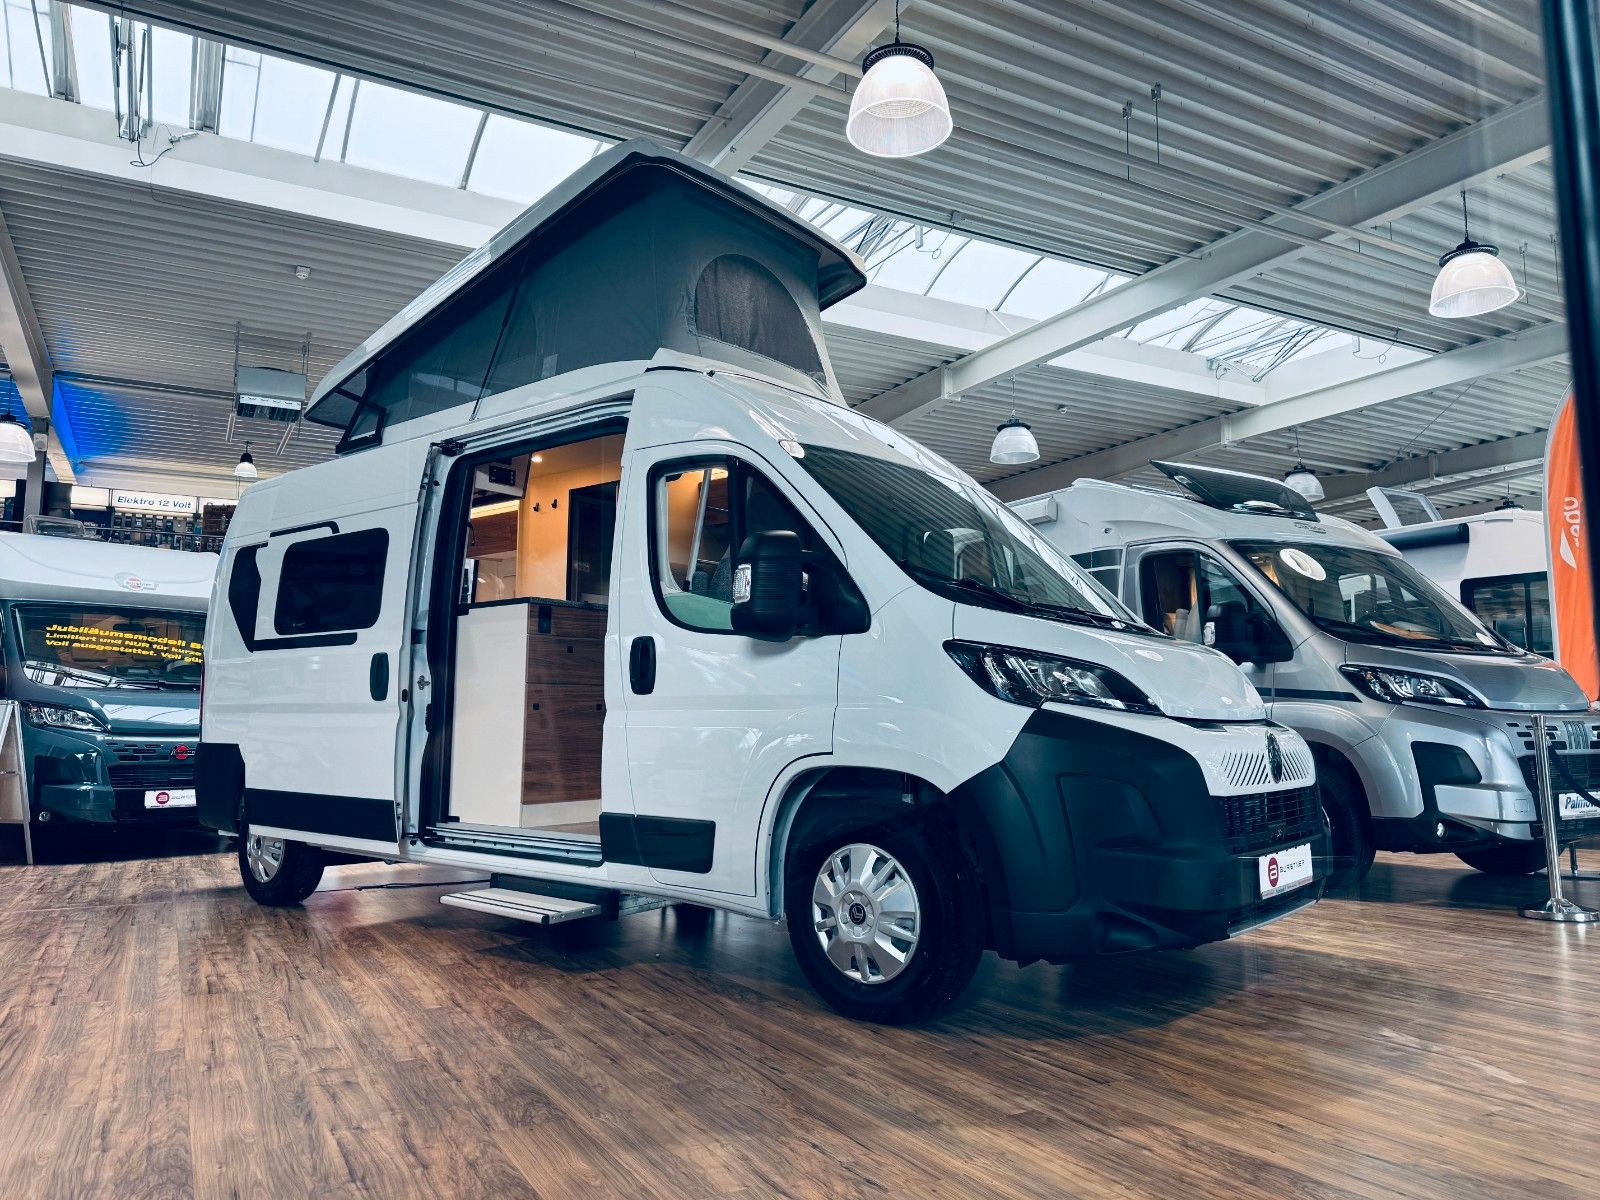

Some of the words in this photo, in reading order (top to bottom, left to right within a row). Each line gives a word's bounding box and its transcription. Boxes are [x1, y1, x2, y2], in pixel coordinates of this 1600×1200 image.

[117, 496, 154, 506] Elektro
[173, 501, 192, 509] Volt
[46, 632, 97, 642] Limitiert
[124, 640, 150, 648] NUR
[153, 643, 169, 651] für
[46, 639, 70, 647] Voll
[161, 651, 182, 660] Voll
